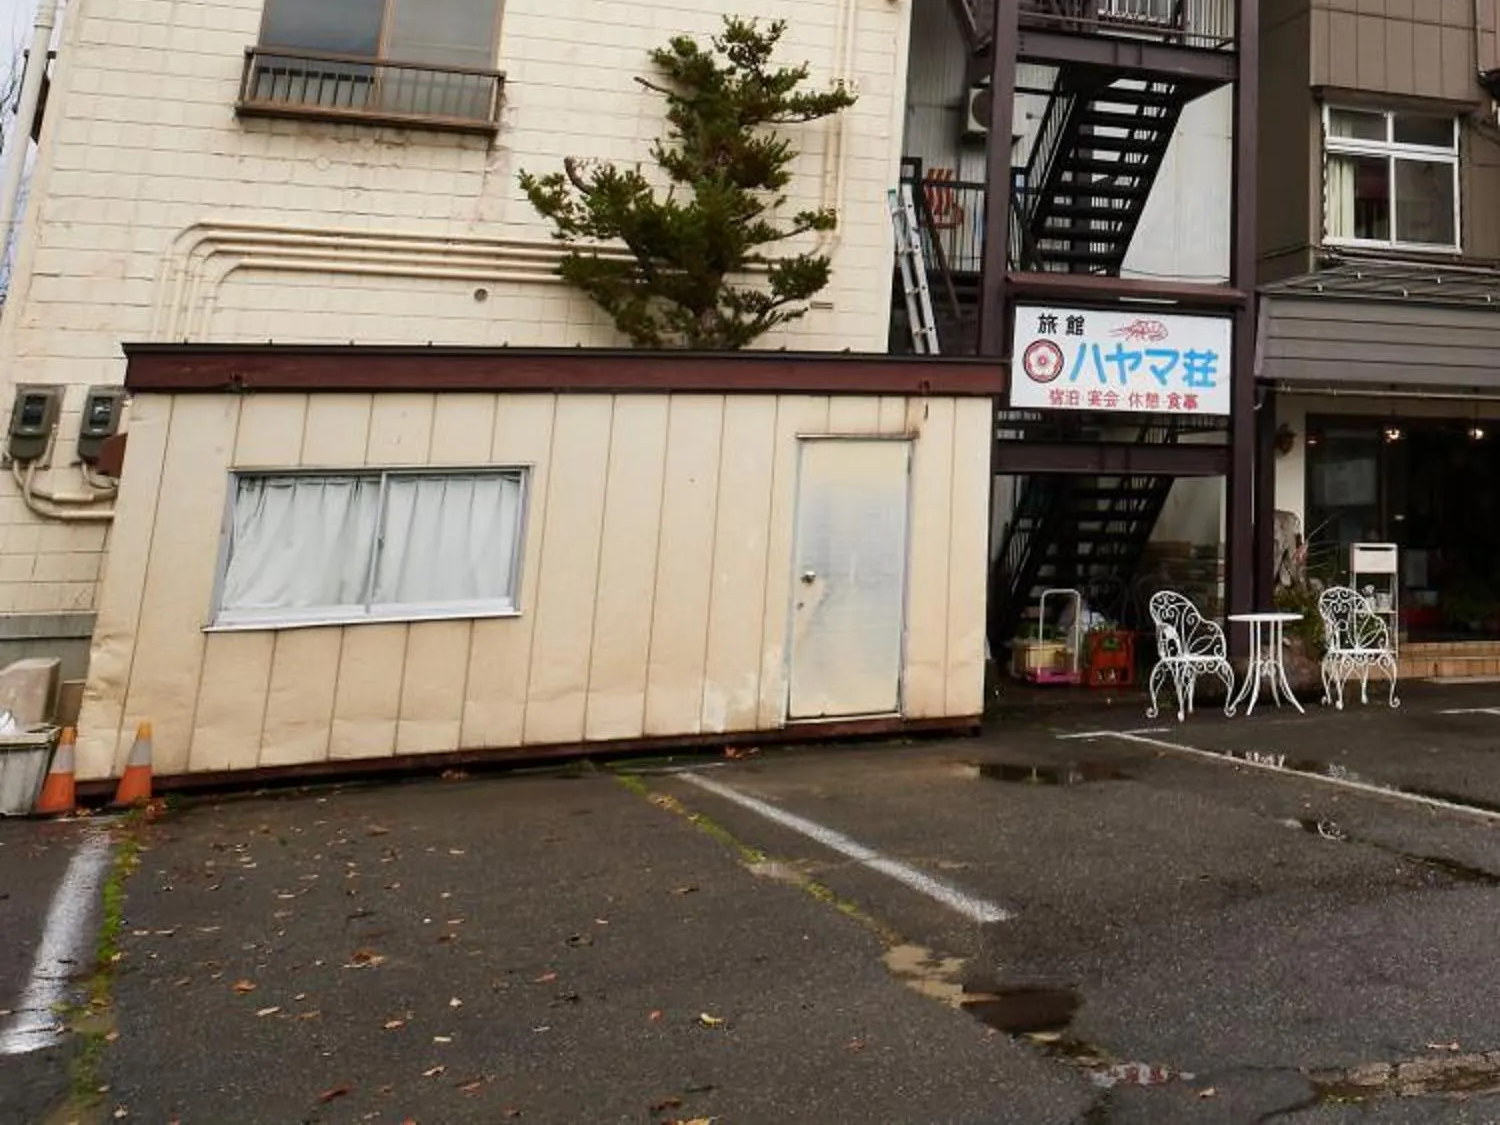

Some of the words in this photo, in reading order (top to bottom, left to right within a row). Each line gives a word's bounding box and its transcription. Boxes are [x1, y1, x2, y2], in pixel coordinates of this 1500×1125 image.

[1038, 313, 1085, 336] 旅館
[1069, 342, 1218, 387] ハヤマ荘
